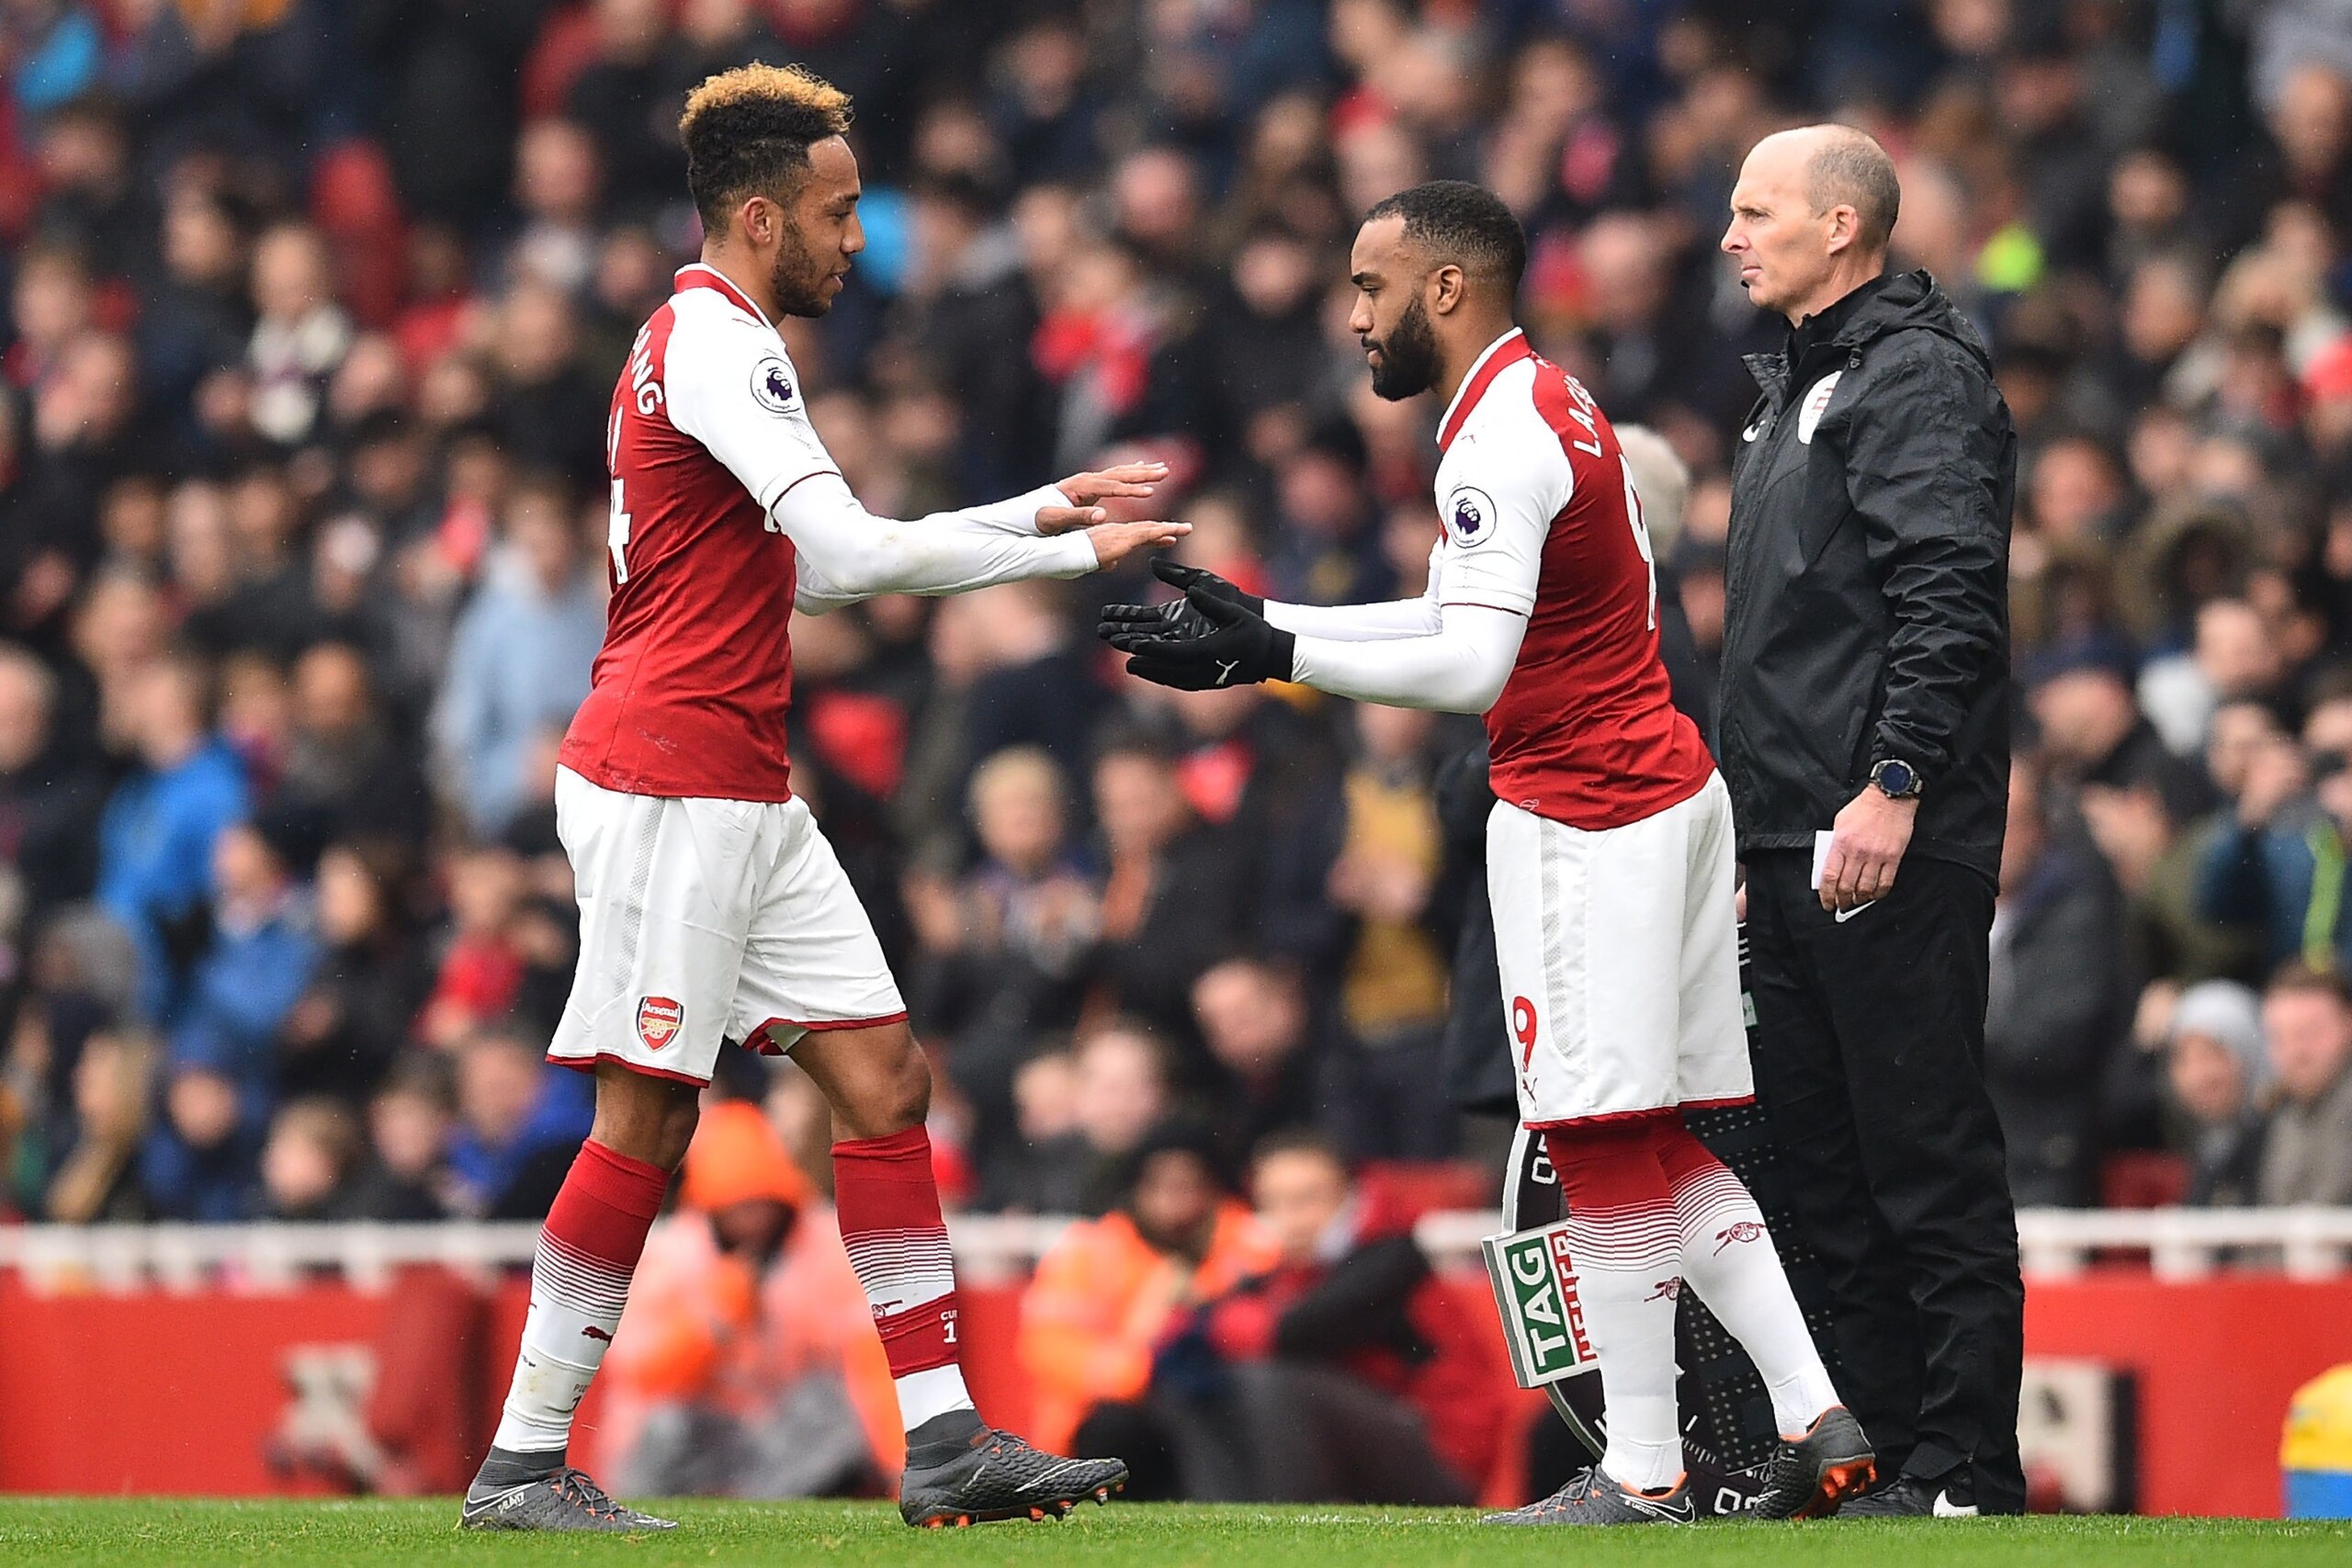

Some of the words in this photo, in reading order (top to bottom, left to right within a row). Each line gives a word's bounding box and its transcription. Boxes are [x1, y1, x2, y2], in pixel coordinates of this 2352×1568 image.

[643, 1003, 678, 1018] Arsenal
[1512, 996, 1537, 1073] 9
[1511, 1247, 1566, 1367] TAG
[943, 1321, 957, 1344] 1
